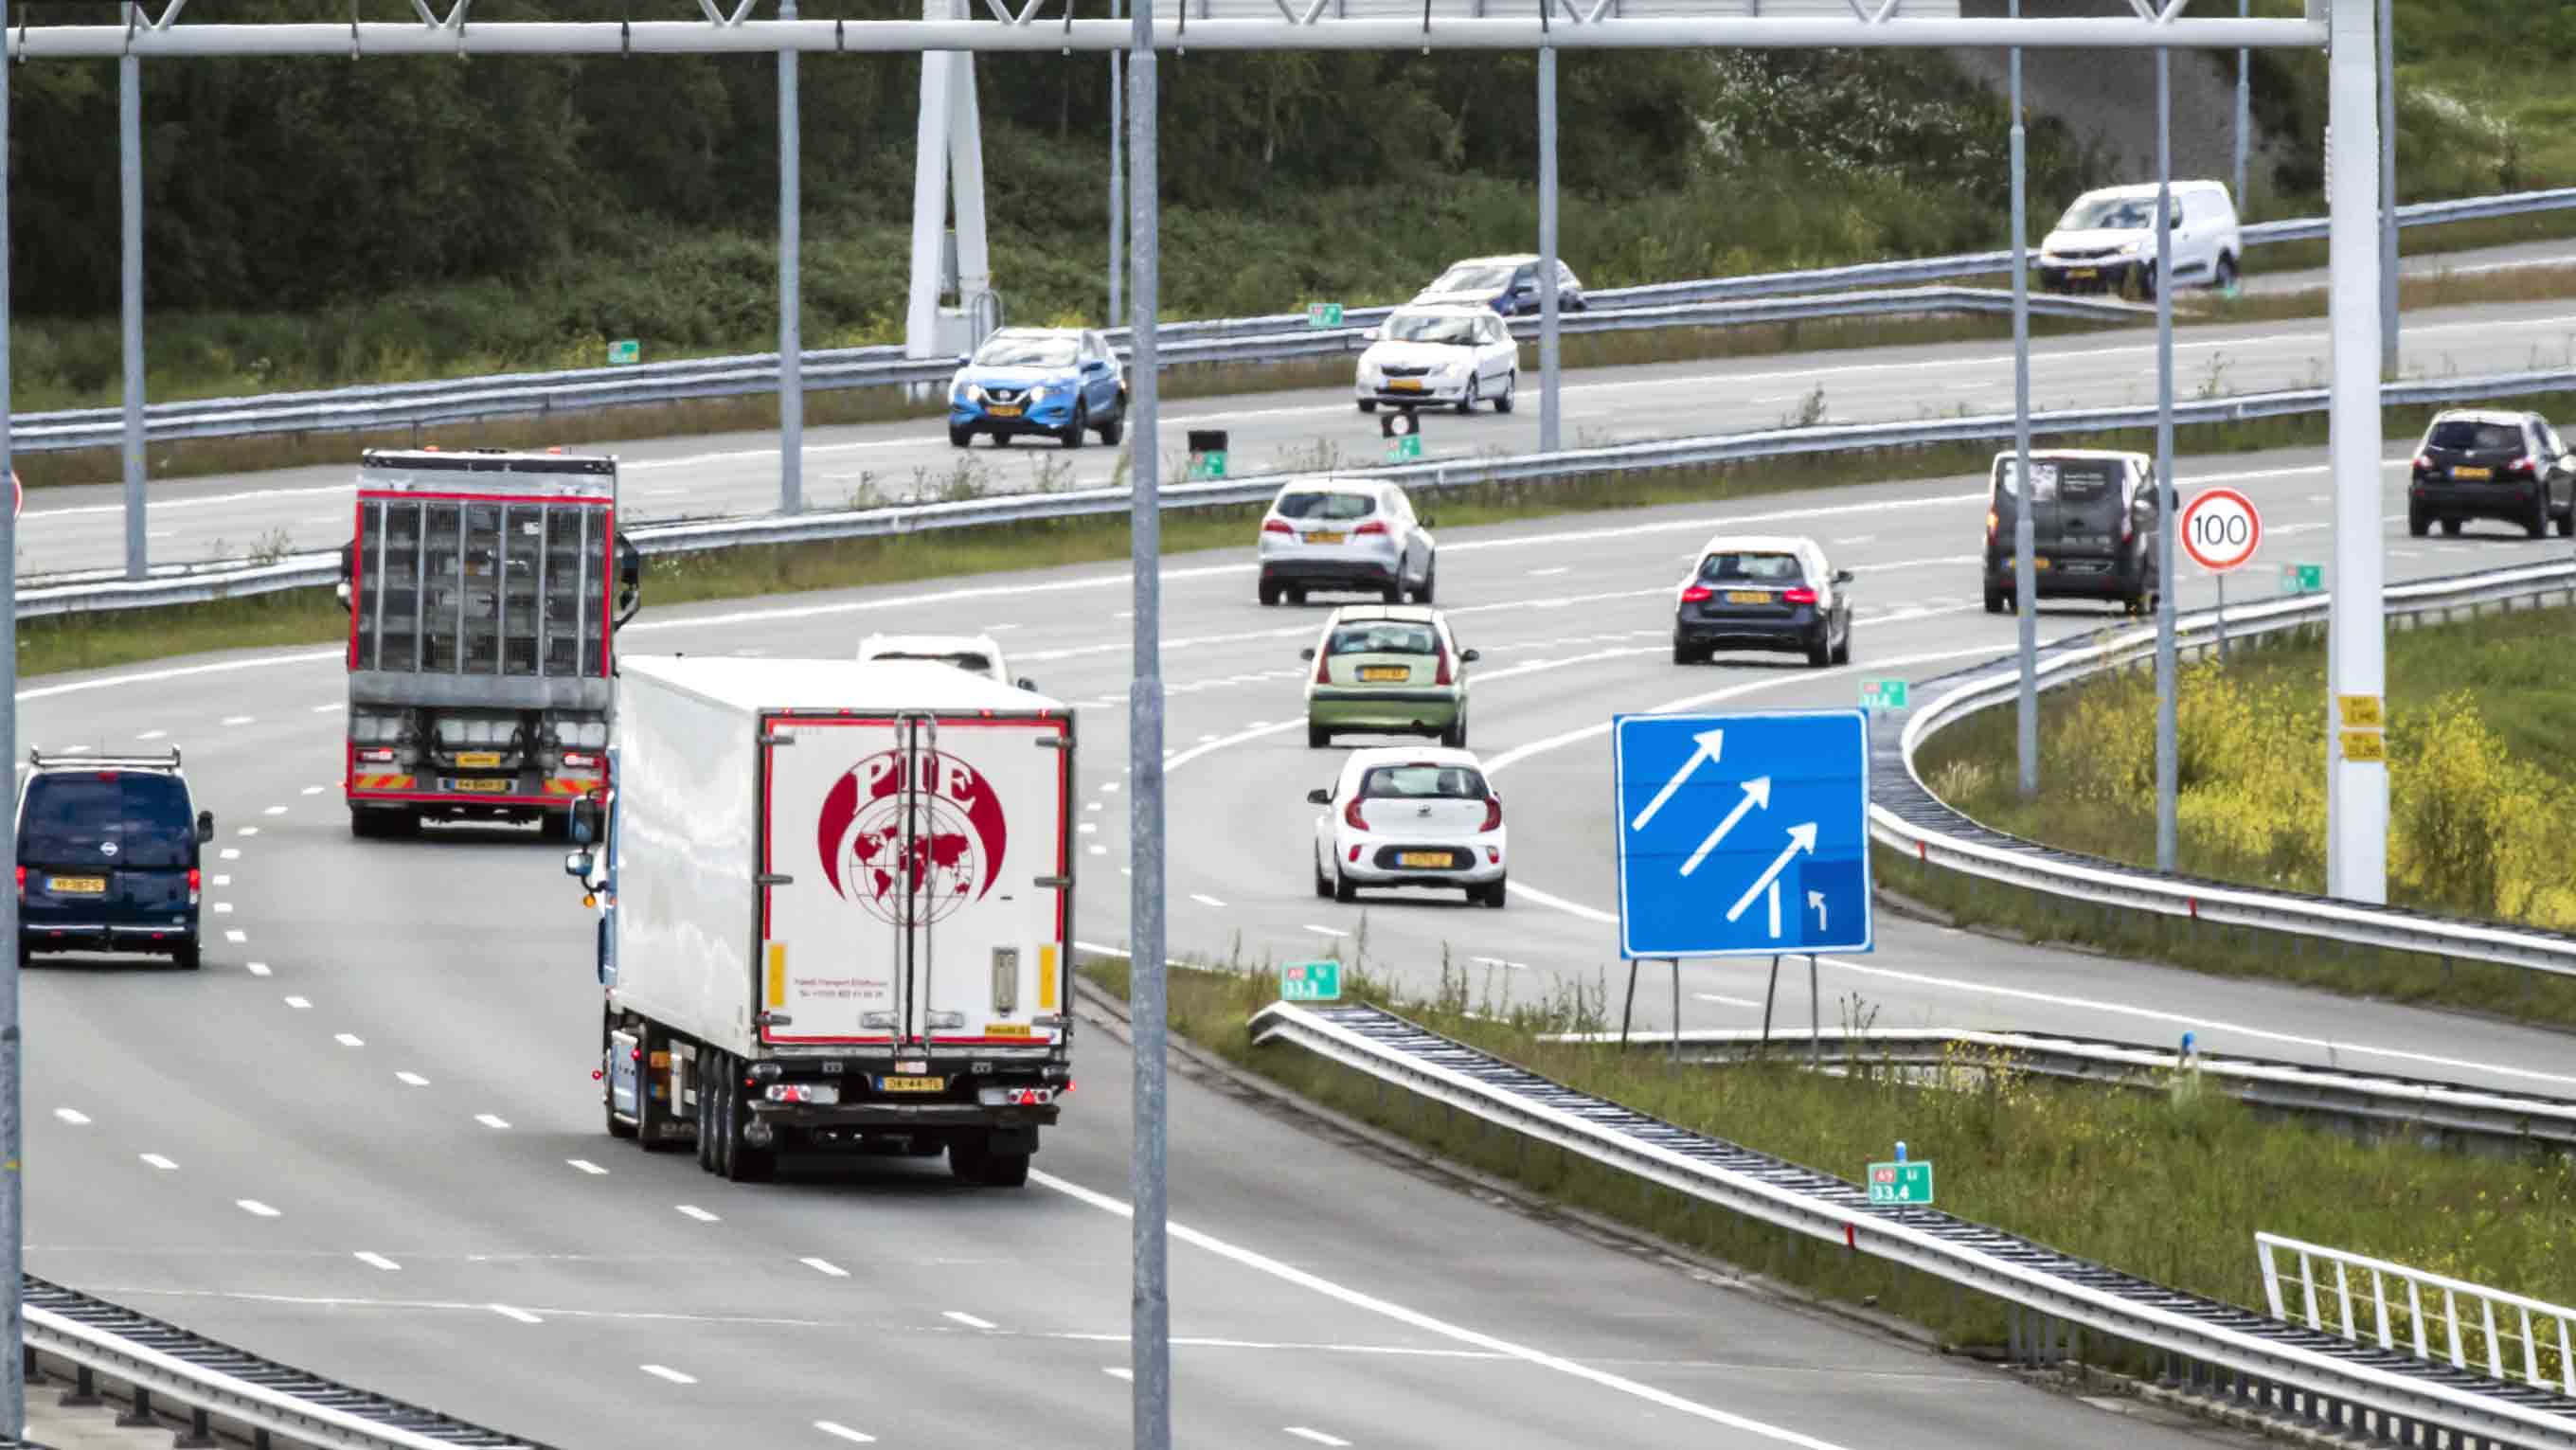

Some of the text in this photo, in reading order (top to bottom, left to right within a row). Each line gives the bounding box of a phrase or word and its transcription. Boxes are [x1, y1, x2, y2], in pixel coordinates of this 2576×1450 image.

[2193, 514, 2247, 546] 100
[848, 747, 976, 816] PIE
[1876, 1170, 1894, 1182] A9
[1871, 1184, 1910, 1201] 33,4
